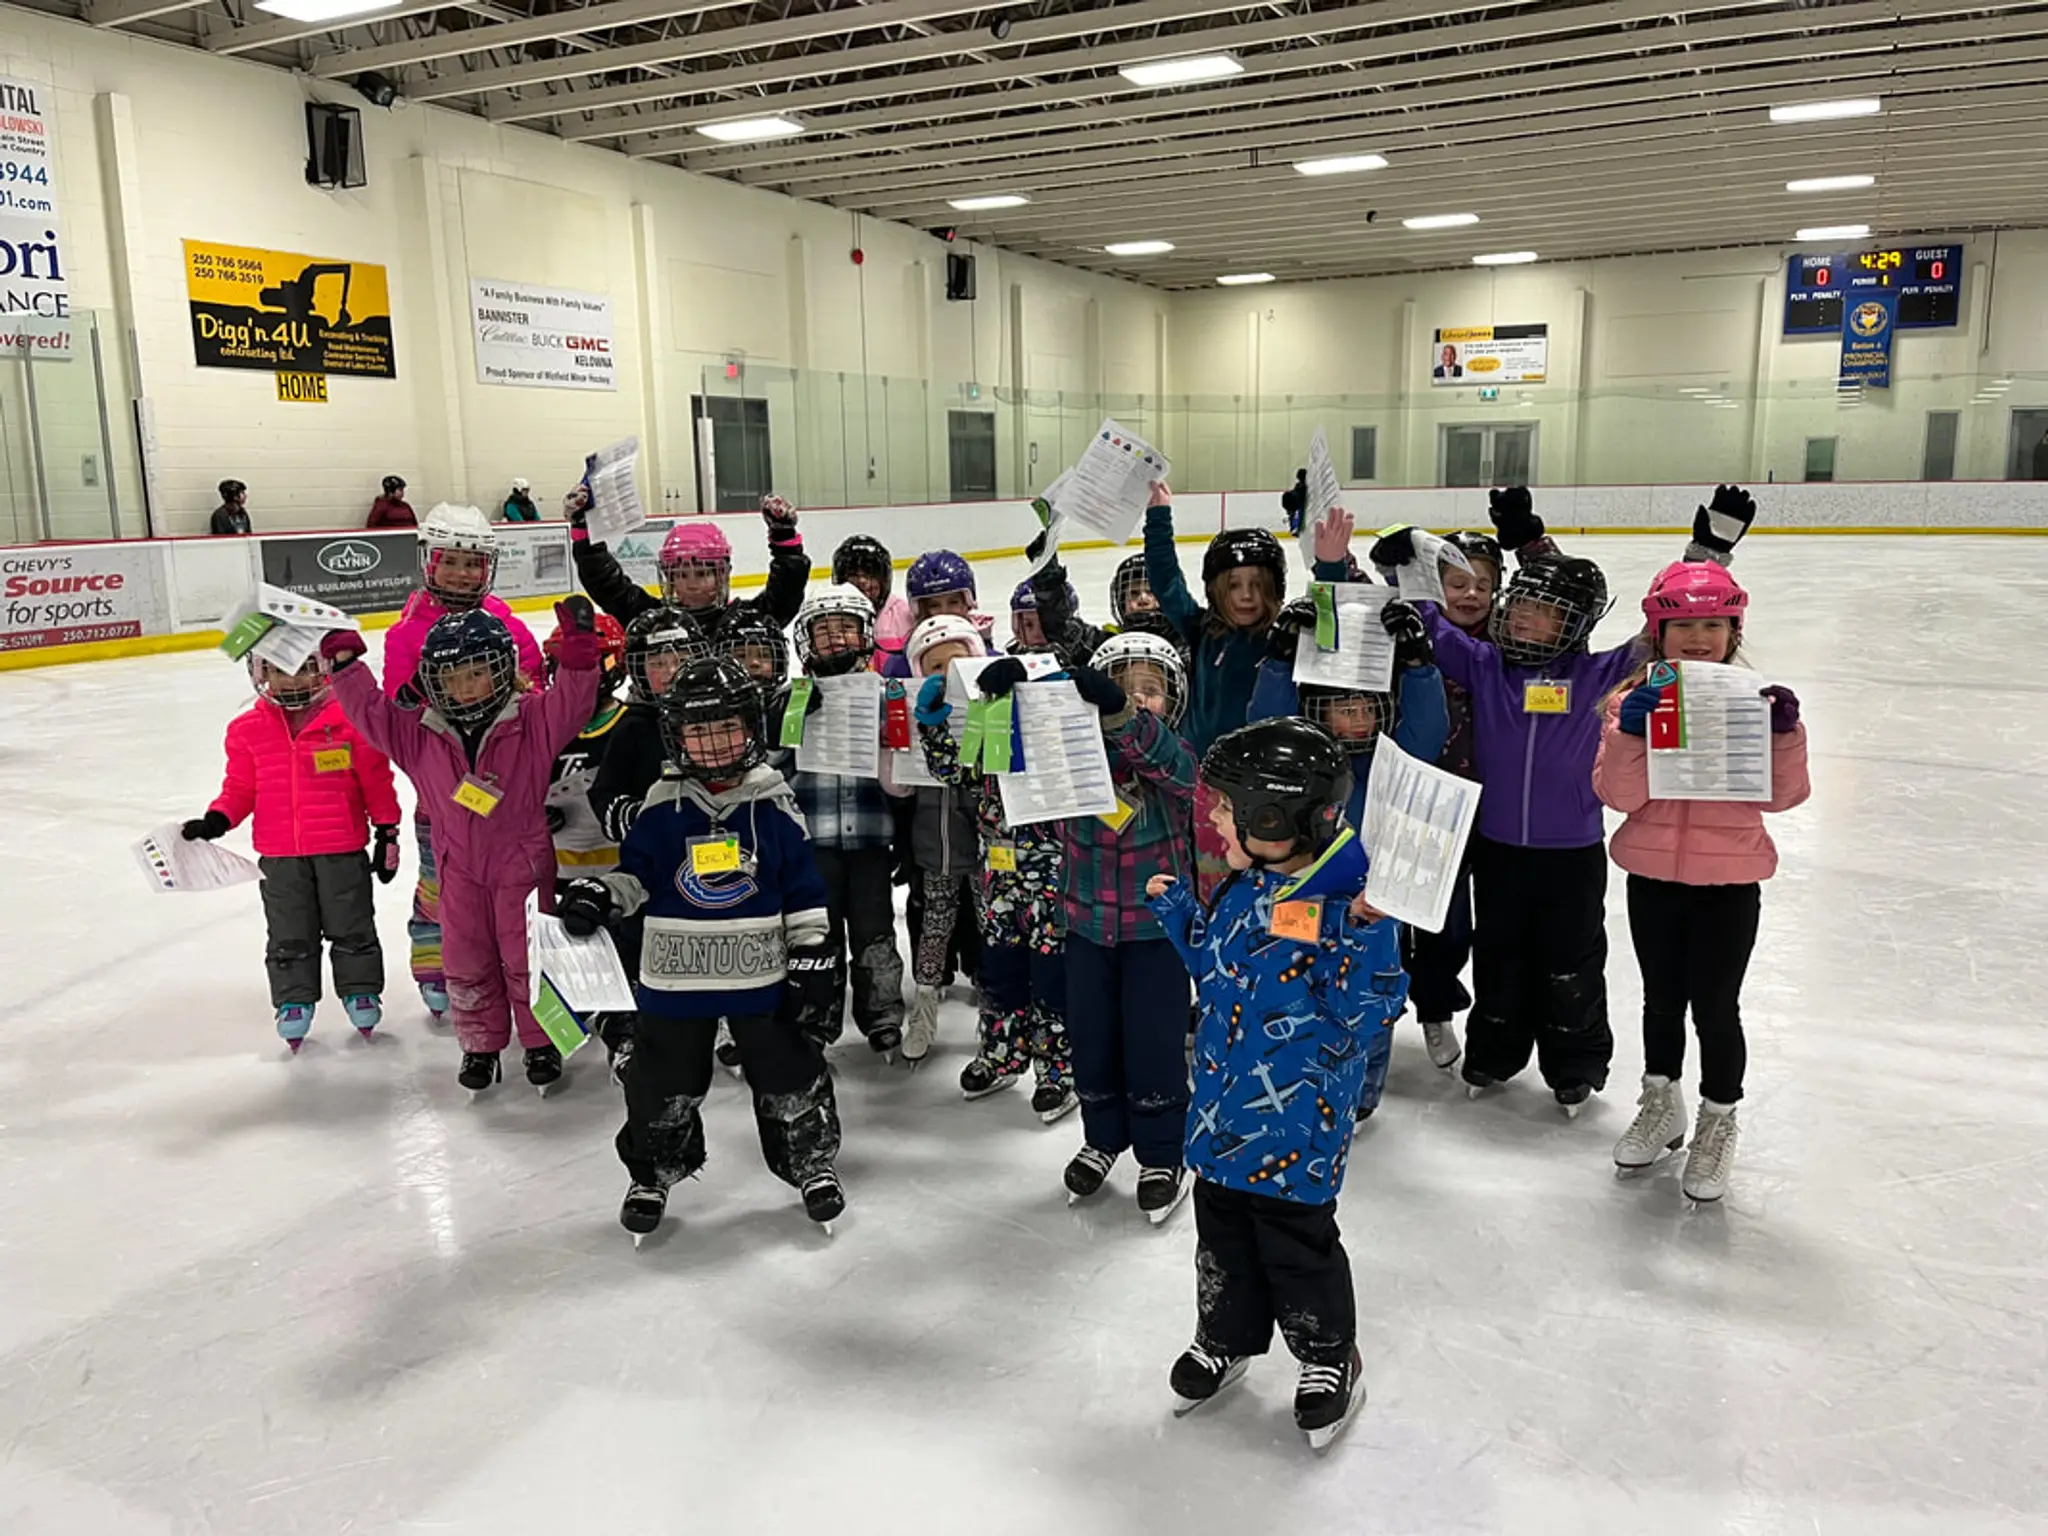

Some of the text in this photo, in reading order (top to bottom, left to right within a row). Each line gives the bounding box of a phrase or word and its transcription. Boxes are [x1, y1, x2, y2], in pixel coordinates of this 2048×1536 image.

[0, 114, 45, 137] LOWSKI
[192, 253, 213, 266] 250
[215, 256, 235, 268] 766
[1802, 255, 1832, 268] HOME
[1860, 251, 1901, 270] 4:29
[1915, 248, 1949, 261] GUEST
[194, 267, 215, 279] 250
[217, 269, 237, 281] 766
[1816, 268, 1828, 286] 0
[1931, 261, 1943, 279] 0
[1812, 290, 1841, 300] PENALTY
[1924, 284, 1954, 294] PENALTY
[514, 291, 545, 305] Business
[478, 307, 529, 325] BANNISTER
[0, 331, 70, 350] vered!
[531, 333, 564, 348] BUICK
[566, 335, 610, 352] GMC
[220, 348, 278, 362] contracting
[575, 354, 613, 368] KELOWNA
[485, 366, 506, 377] Proud
[278, 375, 327, 399] HOME
[3, 557, 72, 573] CHEVY'S
[328, 555, 371, 570] FLYNN
[4, 574, 124, 598] Source
[317, 581, 364, 593] BUILDING
[365, 576, 412, 589] ENVELOPE
[6, 600, 42, 625] for
[62, 625, 136, 643] 250.712.0777
